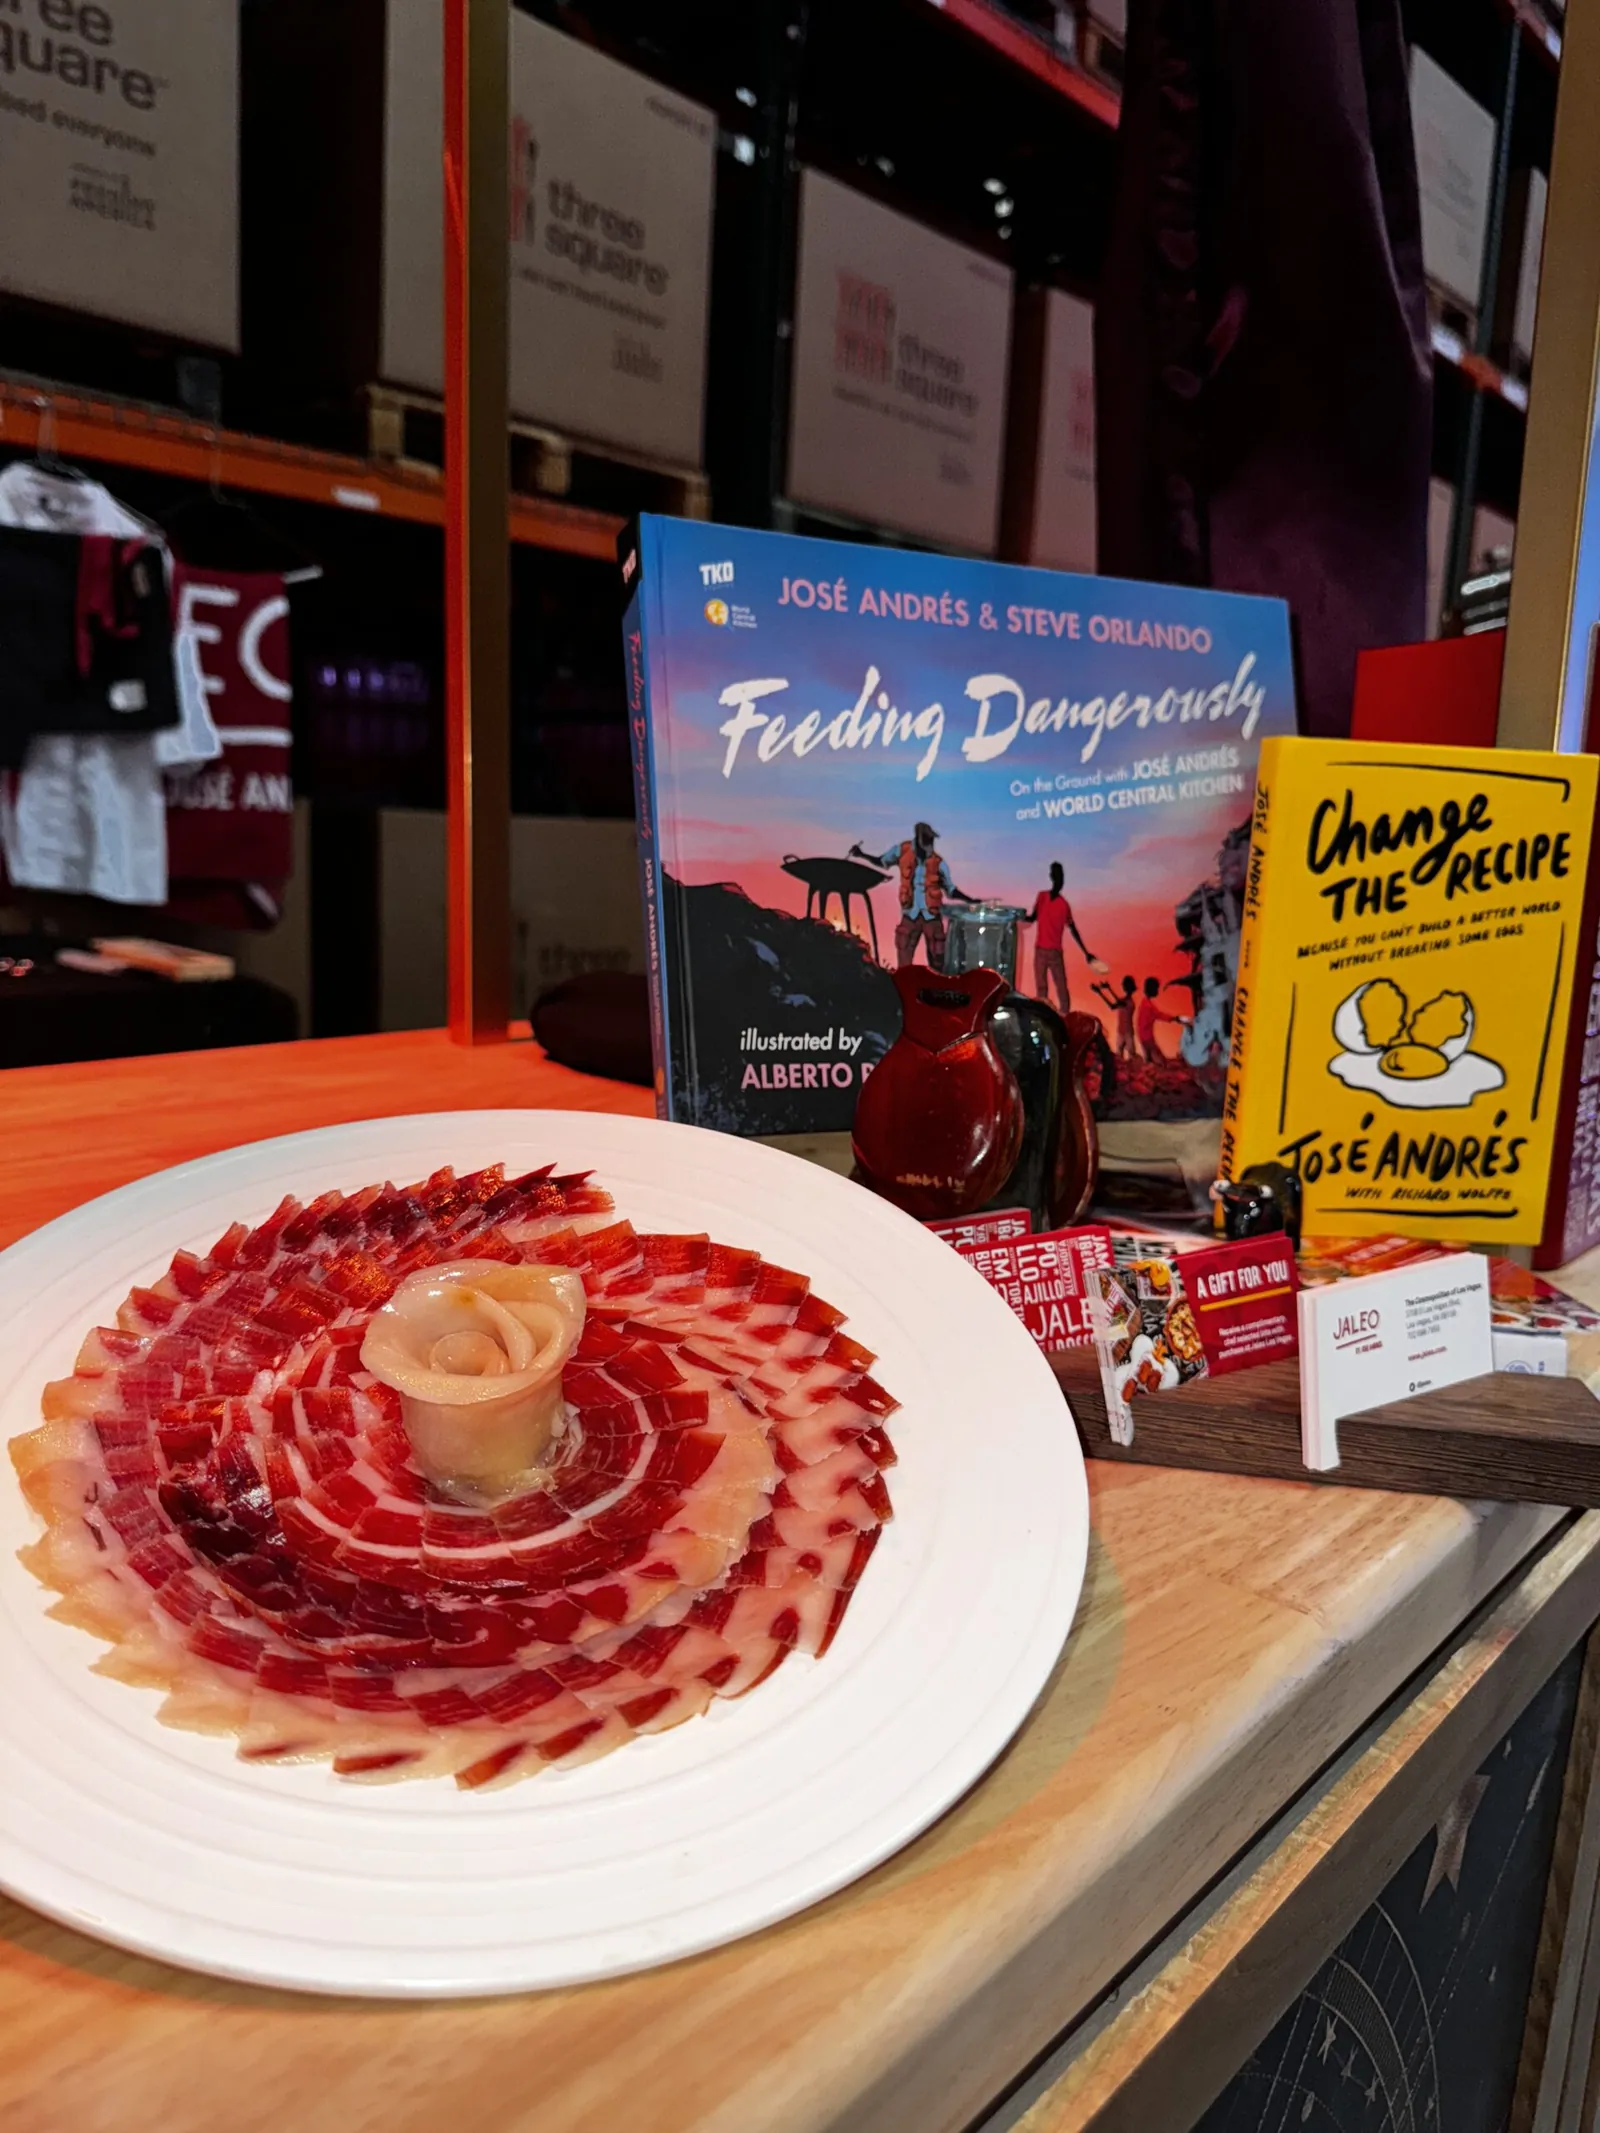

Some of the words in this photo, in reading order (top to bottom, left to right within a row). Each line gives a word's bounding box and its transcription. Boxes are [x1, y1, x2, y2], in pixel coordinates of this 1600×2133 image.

[699, 561, 734, 586] TKO
[778, 576, 848, 613] JOSÉ
[858, 589, 970, 628] ANDRÉS
[978, 602, 999, 631] &
[1007, 605, 1081, 640] STEVE
[1089, 615, 1212, 653] ORLANDO
[718, 665, 944, 782] Feeding
[961, 651, 1266, 764] Dangerously
[1010, 780, 1030, 797] On
[1033, 776, 1053, 793] the
[1055, 770, 1101, 791] Ground
[1104, 767, 1129, 784] with
[1132, 755, 1170, 781] JOSÉ
[1175, 743, 1240, 774] ANDRÉS
[1016, 806, 1041, 821] and
[1043, 794, 1104, 819] WORLD
[1107, 783, 1176, 810] CENTRAL
[1178, 773, 1246, 800] KITCHEN
[1253, 782, 1269, 834] JOSÉ
[1307, 789, 1493, 886] Change
[1246, 845, 1265, 921] ANDRÉS
[1320, 871, 1408, 923] THE
[1444, 832, 1571, 901] RECIPE
[1297, 937, 1348, 959] BECAUSE
[1354, 933, 1376, 947] YOU
[1418, 919, 1452, 935] BUILD
[1456, 915, 1465, 926] A
[1471, 907, 1516, 924] BETTER
[1522, 900, 1561, 915] WORLD
[1329, 952, 1384, 972] WITHOUT
[1389, 940, 1451, 959] BREAKING
[1457, 931, 1490, 946] SOME
[1495, 923, 1524, 938] EGGS
[740, 1026, 834, 1051] illustrated
[838, 1026, 863, 1056] by
[740, 1062, 853, 1090] ALBERTO
[1226, 1080, 1239, 1122] THE
[1277, 1111, 1374, 1184] JOSÉ
[1373, 1109, 1528, 1183] ANDRÉS
[1345, 1187, 1382, 1200] WITH
[1391, 1187, 1451, 1201] RICHARD
[1458, 1187, 1511, 1200] WOLFFE
[991, 1248, 1012, 1280] EM
[1017, 1244, 1040, 1282] LLO
[1197, 1276, 1209, 1299] A
[1208, 1270, 1236, 1296] GIFT
[1237, 1265, 1264, 1290] FOR
[1262, 1259, 1289, 1284] YOU
[1024, 1279, 1064, 1304] AJILLO
[1333, 1309, 1380, 1340] JALEO
